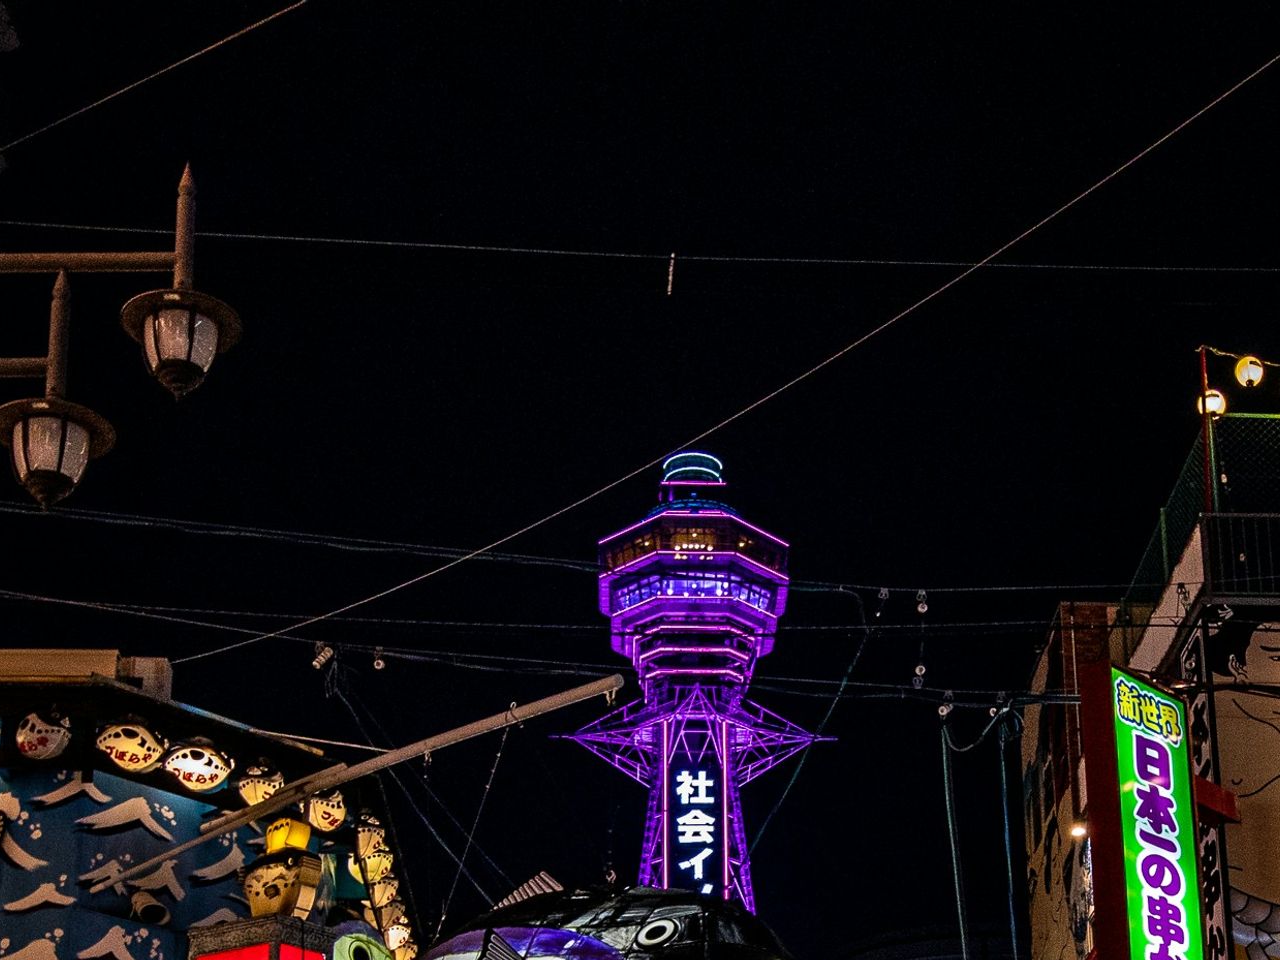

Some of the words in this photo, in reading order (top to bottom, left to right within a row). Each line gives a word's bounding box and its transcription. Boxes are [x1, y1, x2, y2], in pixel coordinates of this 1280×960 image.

[1117, 680, 1181, 745] 新世界
[676, 770, 716, 894] 社会イ
